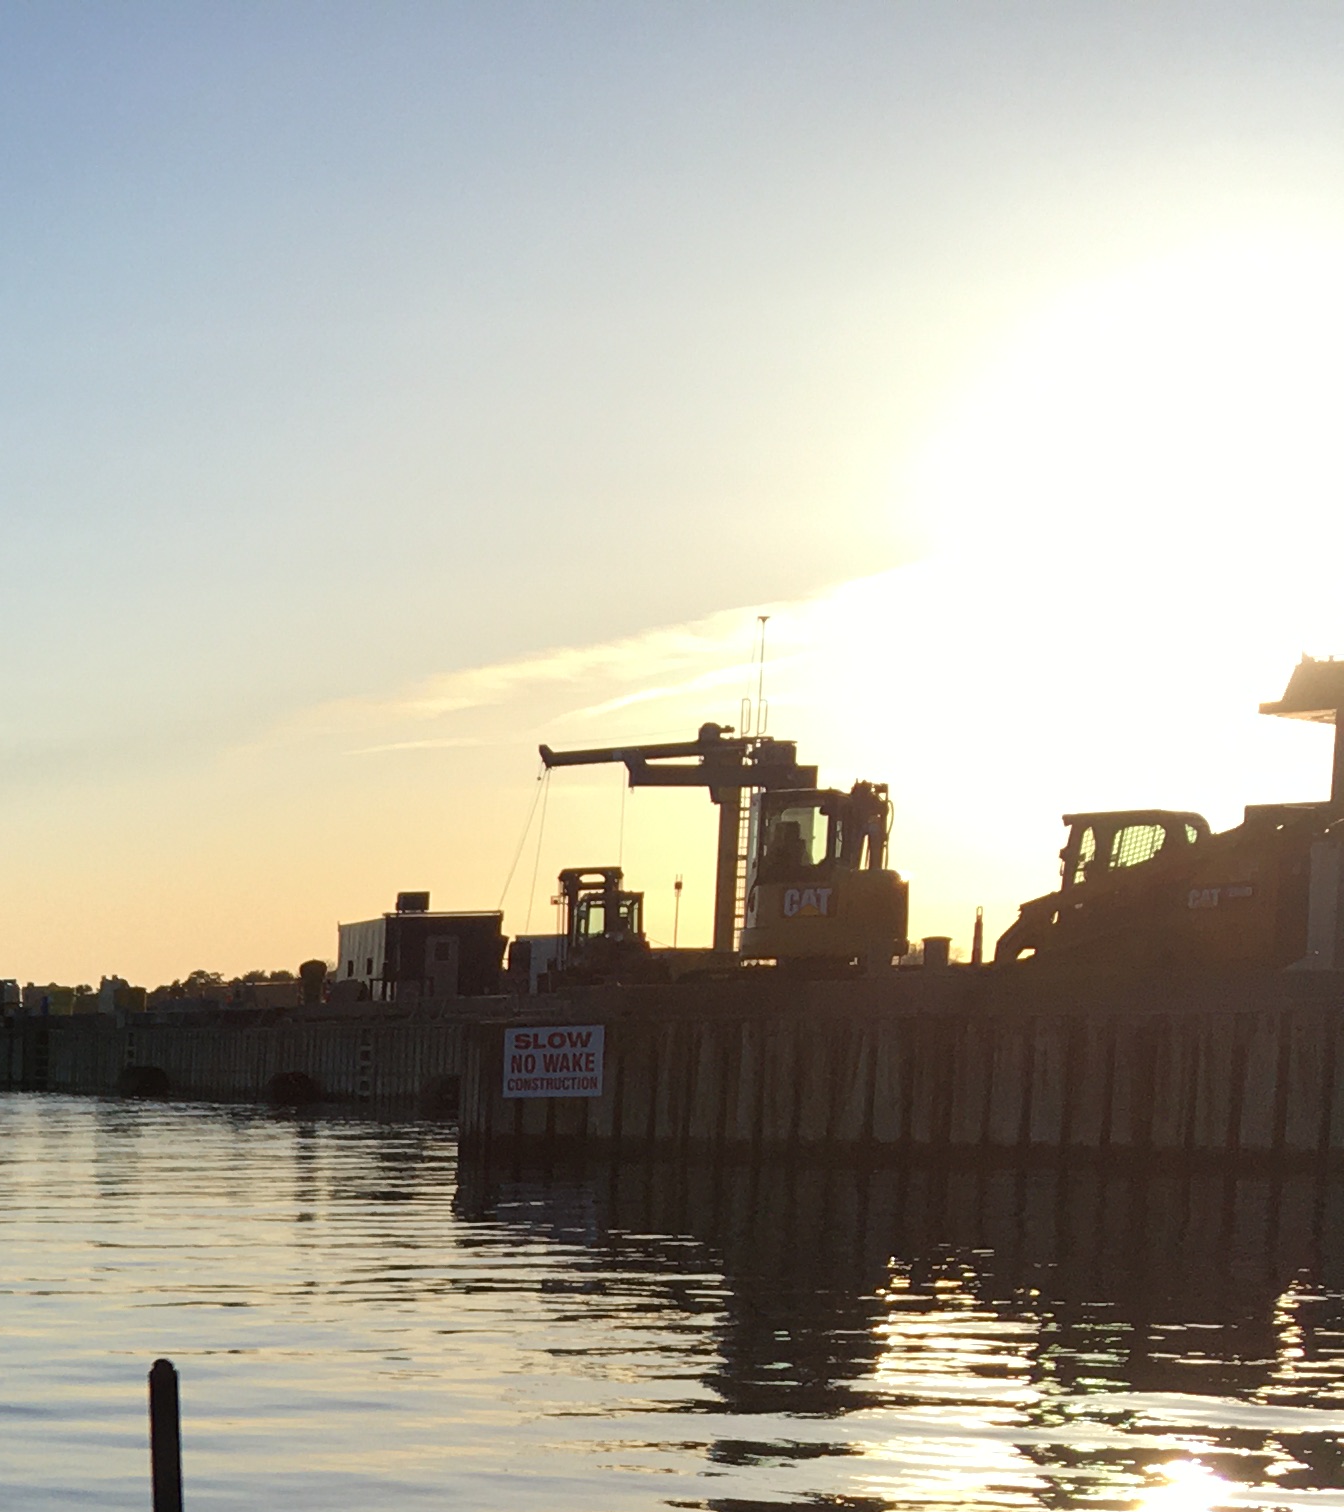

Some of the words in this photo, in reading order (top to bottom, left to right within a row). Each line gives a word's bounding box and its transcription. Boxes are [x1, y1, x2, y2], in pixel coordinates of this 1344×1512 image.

[783, 888, 833, 916] CAT
[1187, 888, 1221, 909] CAT
[514, 1031, 592, 1050] SLOW
[511, 1054, 536, 1074] NO
[543, 1052, 595, 1073] WAKE
[507, 1076, 598, 1091] CONSTRUCTION
